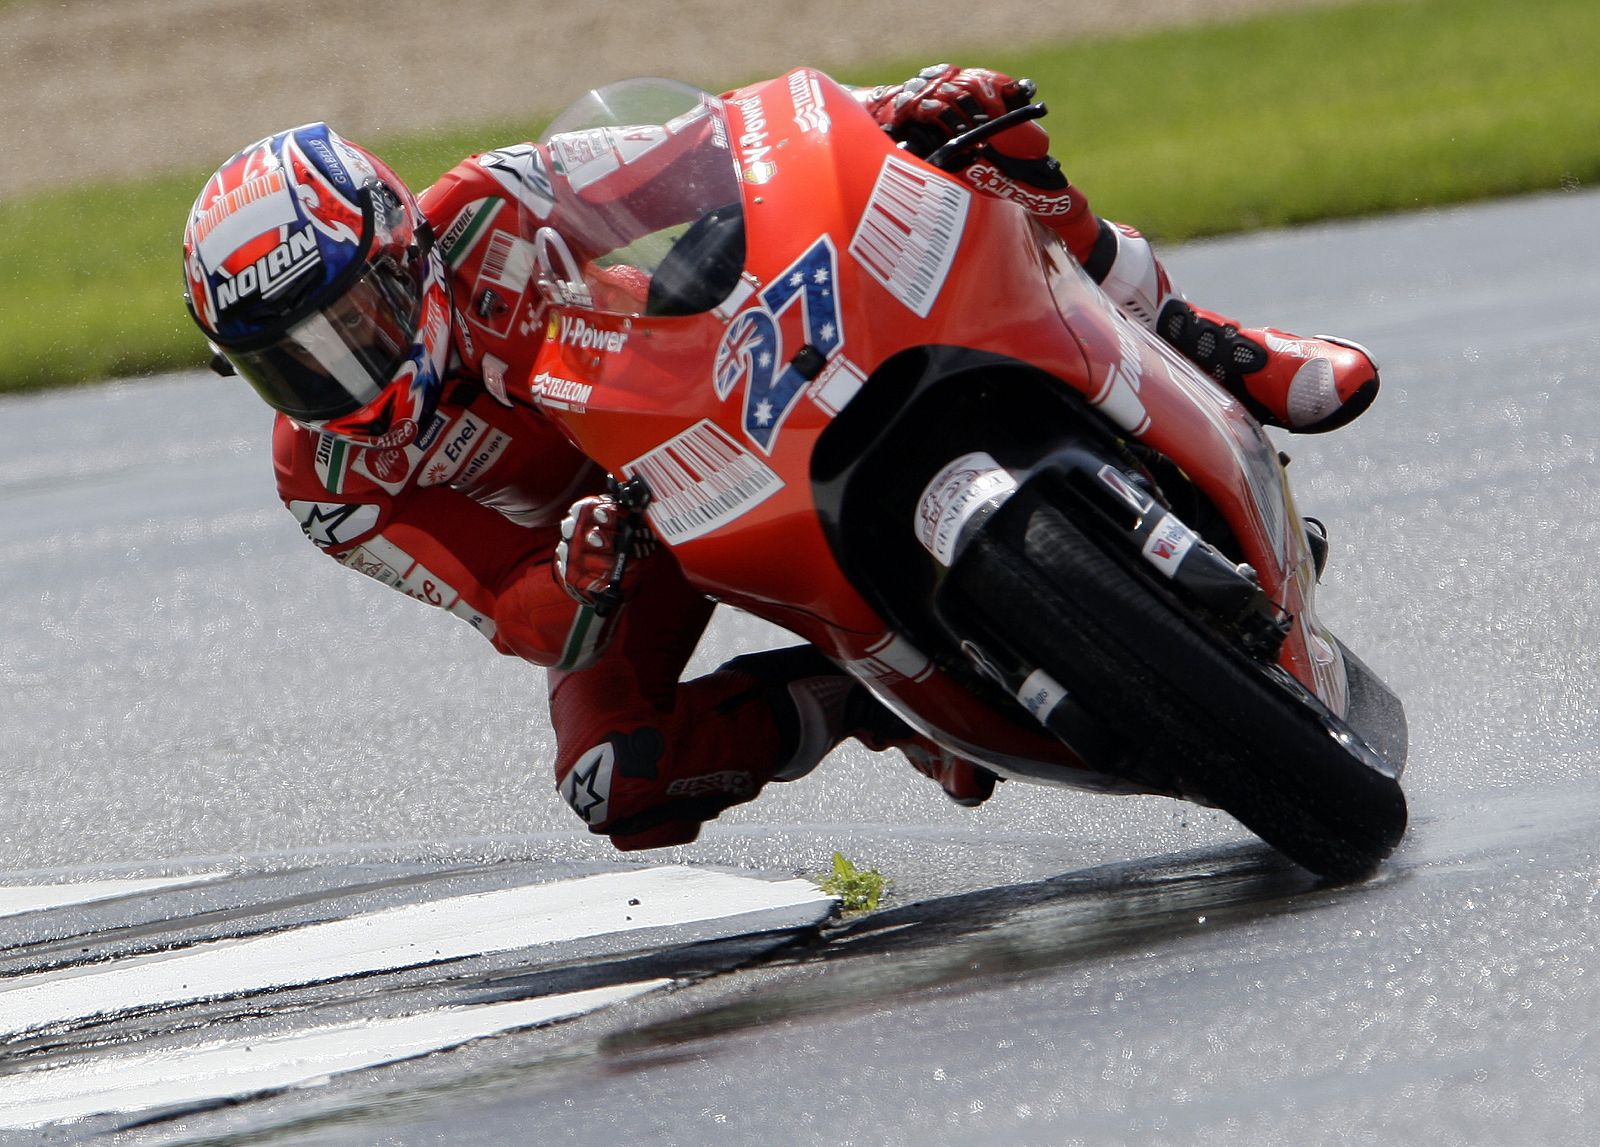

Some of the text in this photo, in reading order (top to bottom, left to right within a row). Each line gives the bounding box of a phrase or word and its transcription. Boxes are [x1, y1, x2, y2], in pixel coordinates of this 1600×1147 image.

[441, 204, 475, 251] ESTONE
[216, 223, 318, 311] NOLAN
[561, 315, 629, 353] V-Power
[713, 233, 845, 457] 27
[548, 377, 593, 404] TELECOM
[443, 418, 478, 463] Enel
[487, 434, 503, 453] ups
